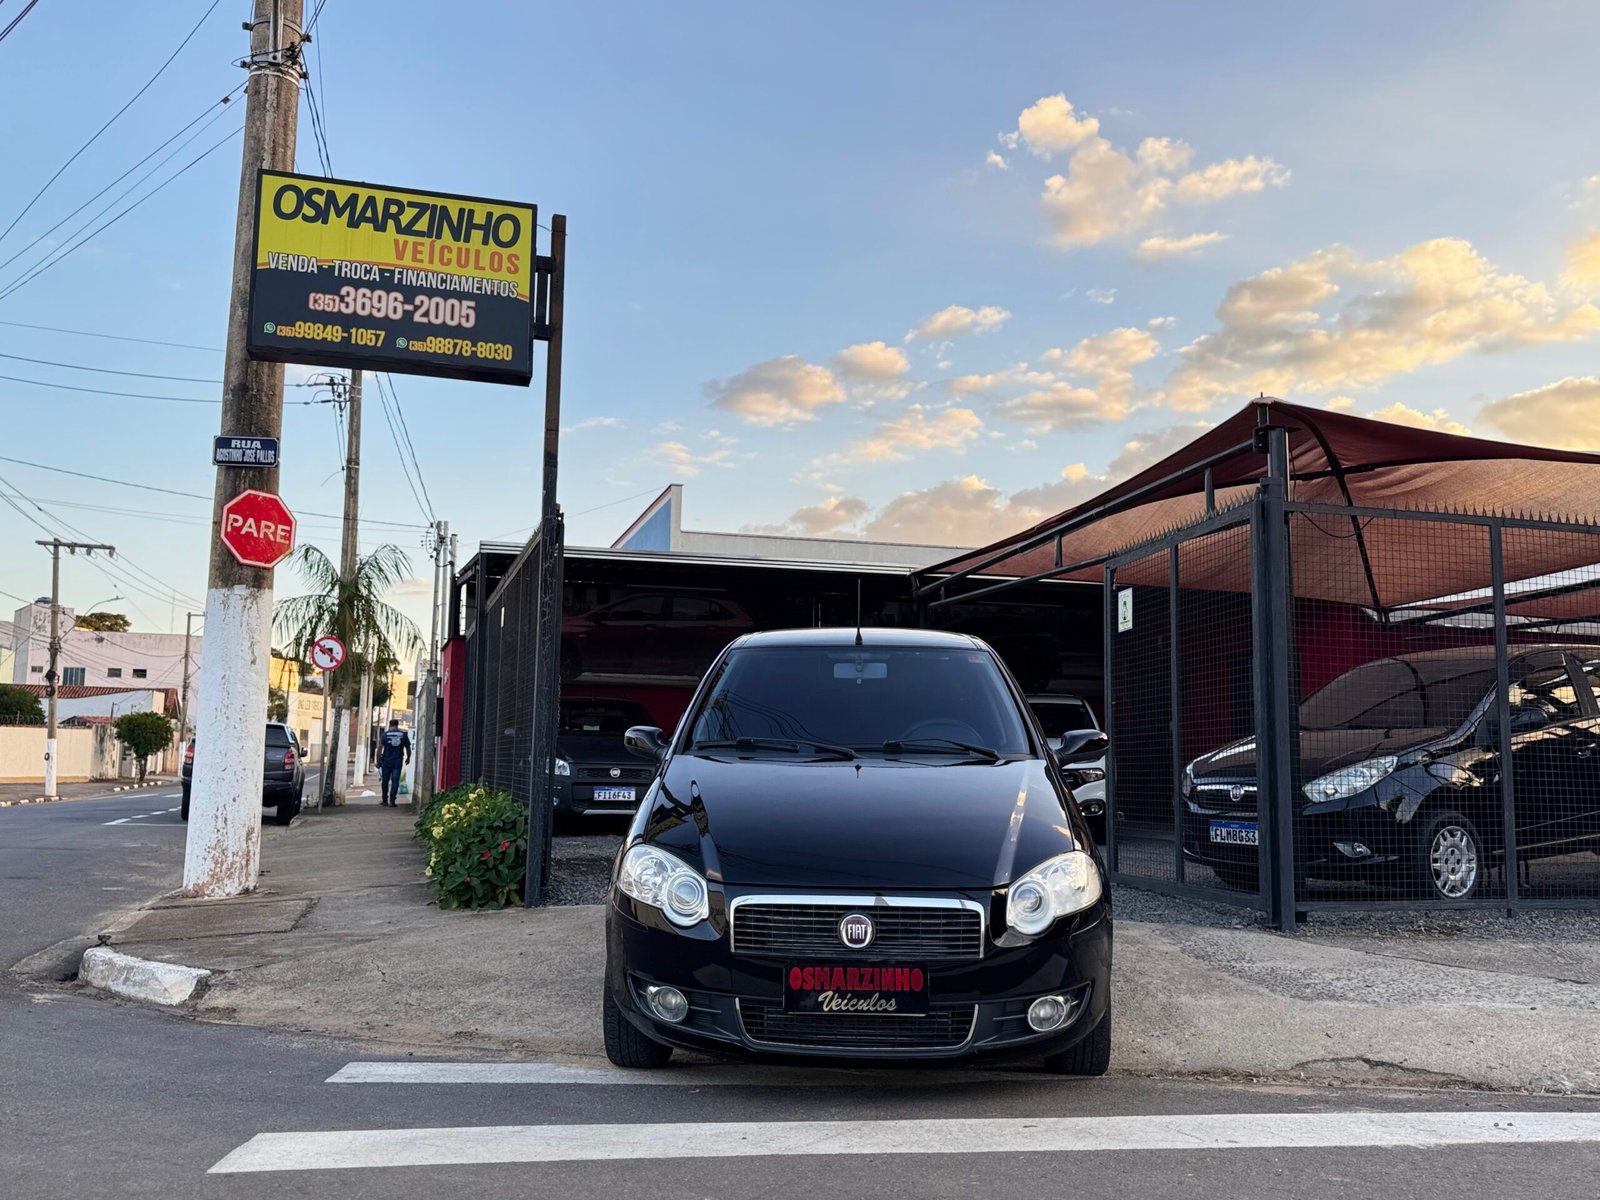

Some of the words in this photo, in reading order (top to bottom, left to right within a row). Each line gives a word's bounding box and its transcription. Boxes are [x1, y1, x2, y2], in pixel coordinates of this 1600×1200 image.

[273, 184, 521, 248] OSMARZINHO
[393, 238, 520, 274] VEÍCULOS
[268, 252, 318, 274] VENDA
[333, 260, 380, 282] TROCA
[394, 268, 519, 298] FINANCIAMENTOS
[231, 439, 261, 449] RUA
[226, 513, 291, 545] PARE
[1214, 828, 1257, 844] FLM8G33
[847, 924, 867, 940] FIAT
[789, 966, 924, 992] OSMARZINHO
